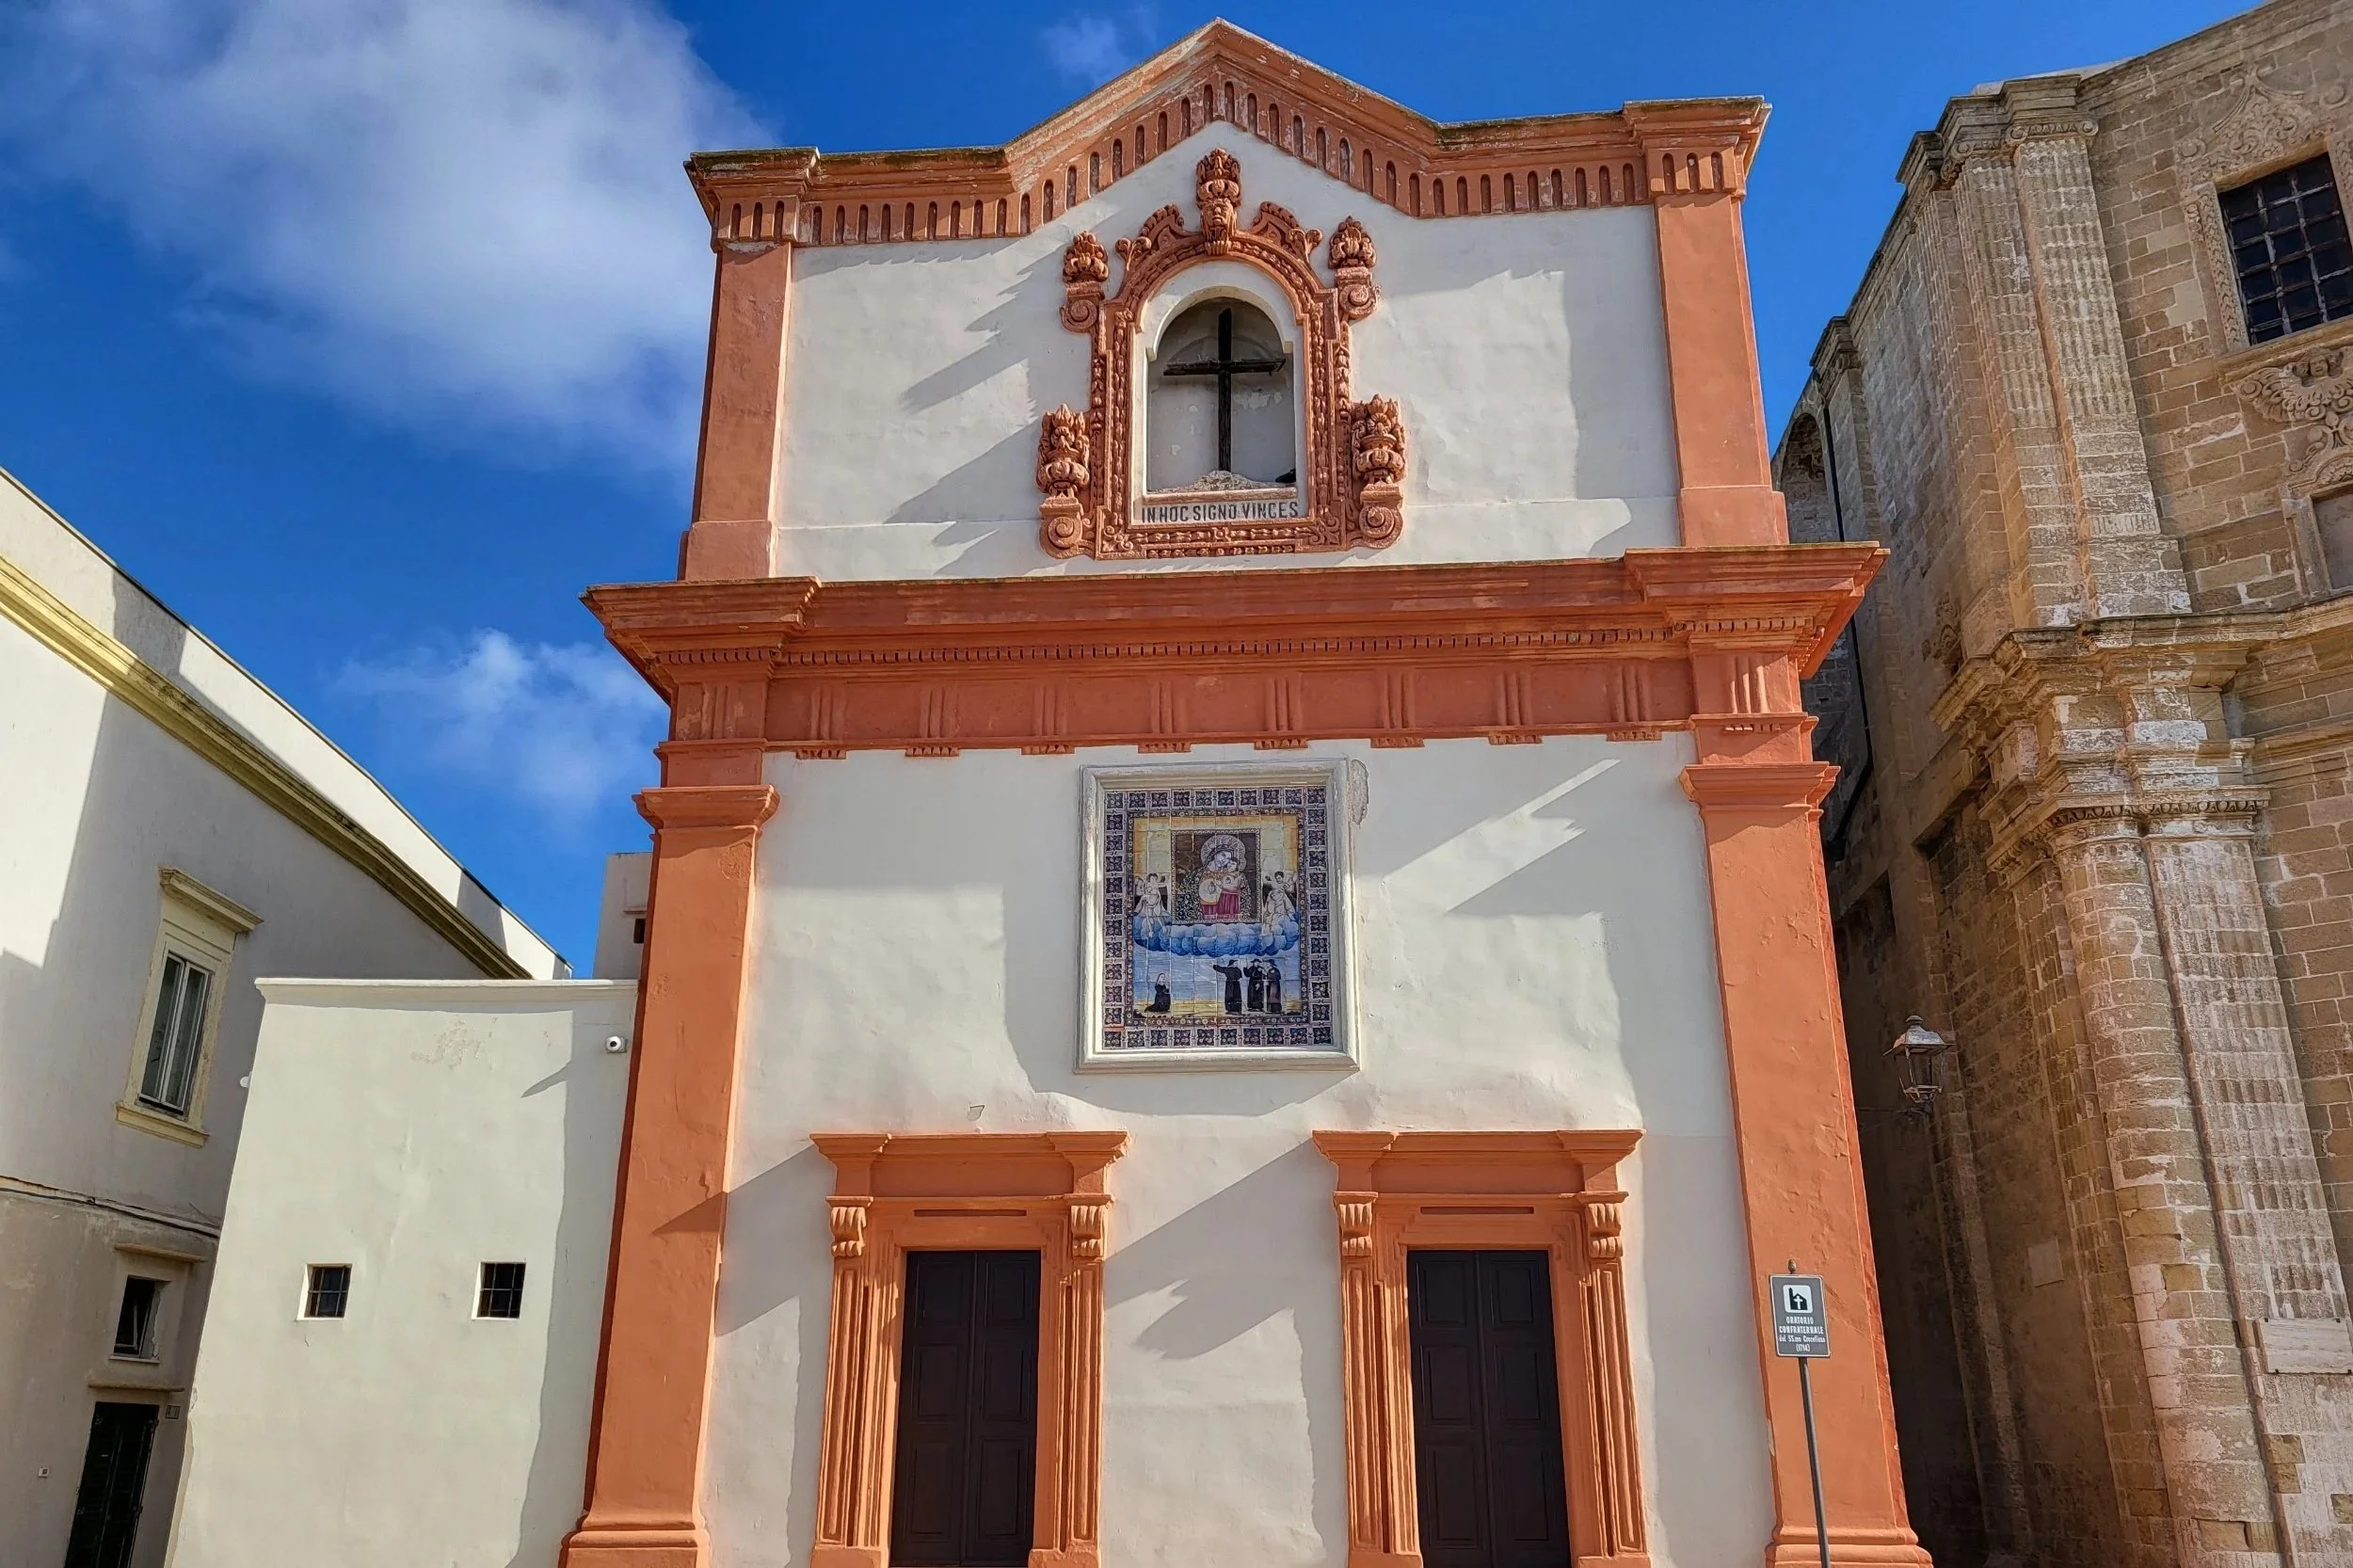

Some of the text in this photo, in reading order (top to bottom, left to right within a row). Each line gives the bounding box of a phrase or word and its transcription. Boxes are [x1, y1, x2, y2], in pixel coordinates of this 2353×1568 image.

[1142, 501, 1299, 522] IN HOC SIGNO VINCES
